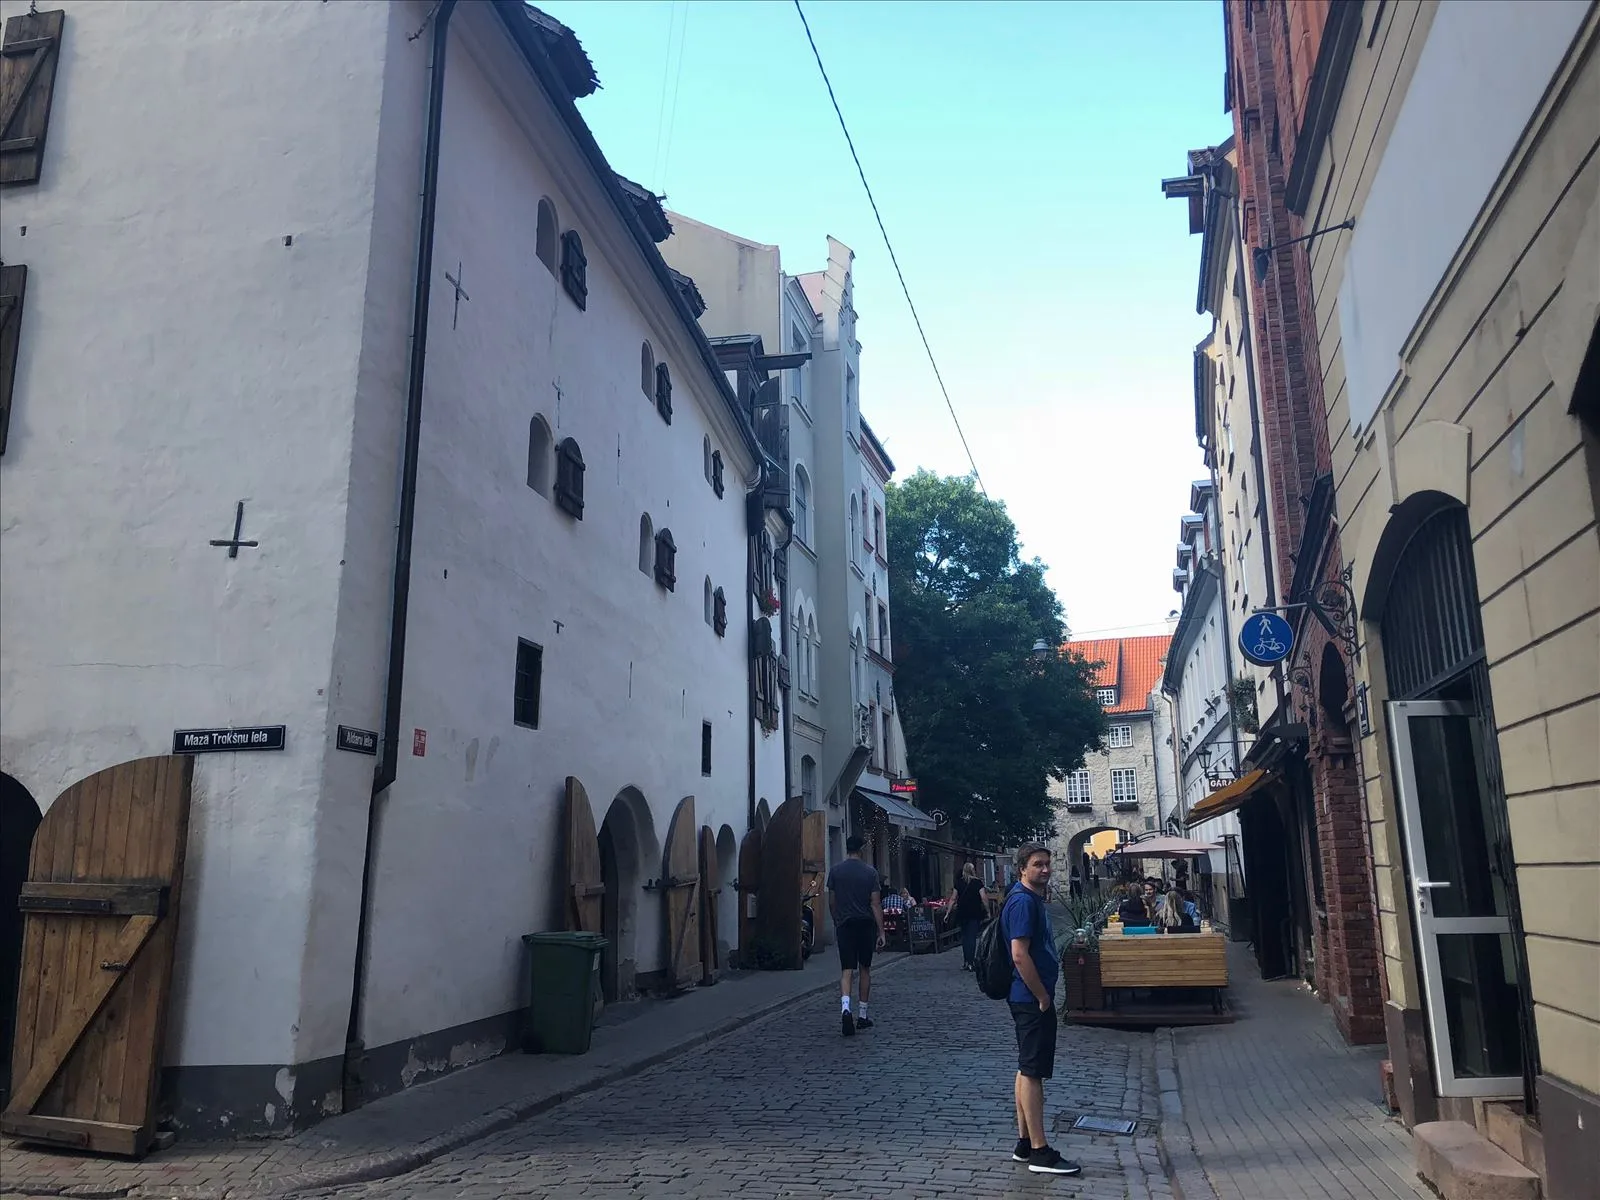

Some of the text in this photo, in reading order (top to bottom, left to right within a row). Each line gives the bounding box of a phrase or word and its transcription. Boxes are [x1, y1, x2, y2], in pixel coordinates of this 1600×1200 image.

[184, 730, 268, 747] Mazā Trokšņu iela
[1210, 779, 1235, 787] GARA
